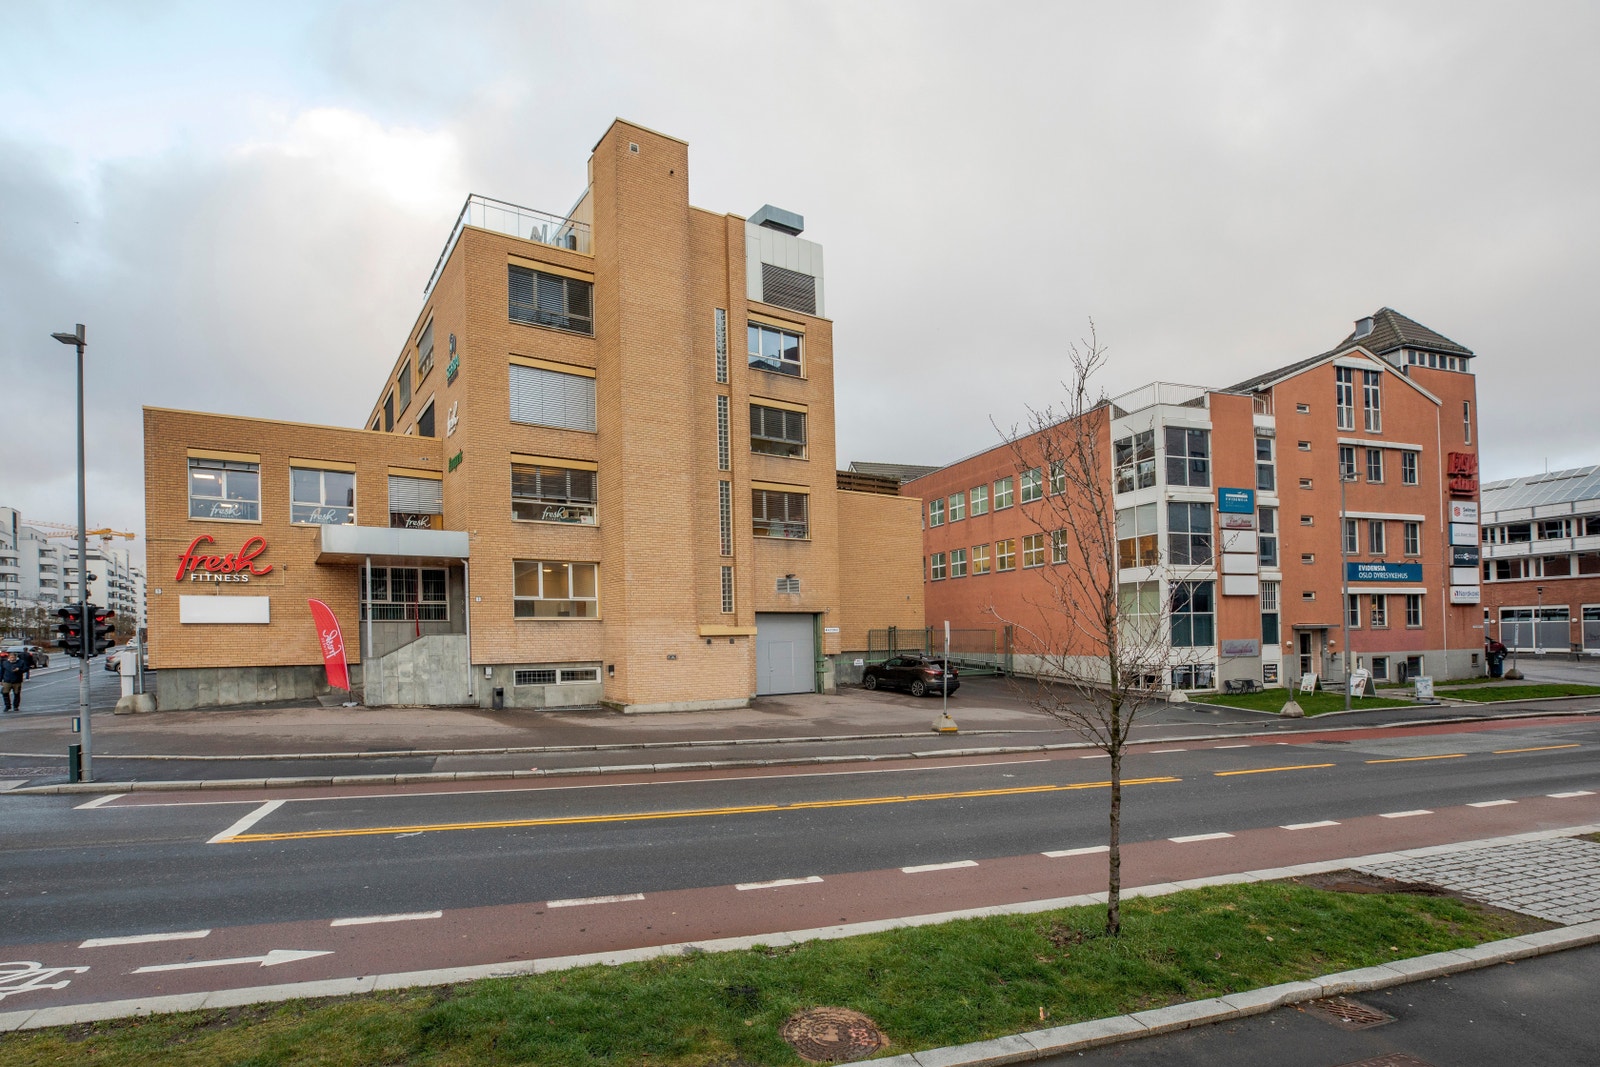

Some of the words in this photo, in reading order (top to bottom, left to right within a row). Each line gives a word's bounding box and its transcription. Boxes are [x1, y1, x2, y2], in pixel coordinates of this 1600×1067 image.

[210, 502, 241, 517] fresh
[310, 507, 338, 522] fresh
[542, 505, 567, 520] fresh
[405, 514, 431, 528] fresh
[175, 534, 273, 581] fresh
[190, 573, 249, 582] FITNESS
[1358, 571, 1372, 579] OSLO
[323, 629, 342, 659] fresh
